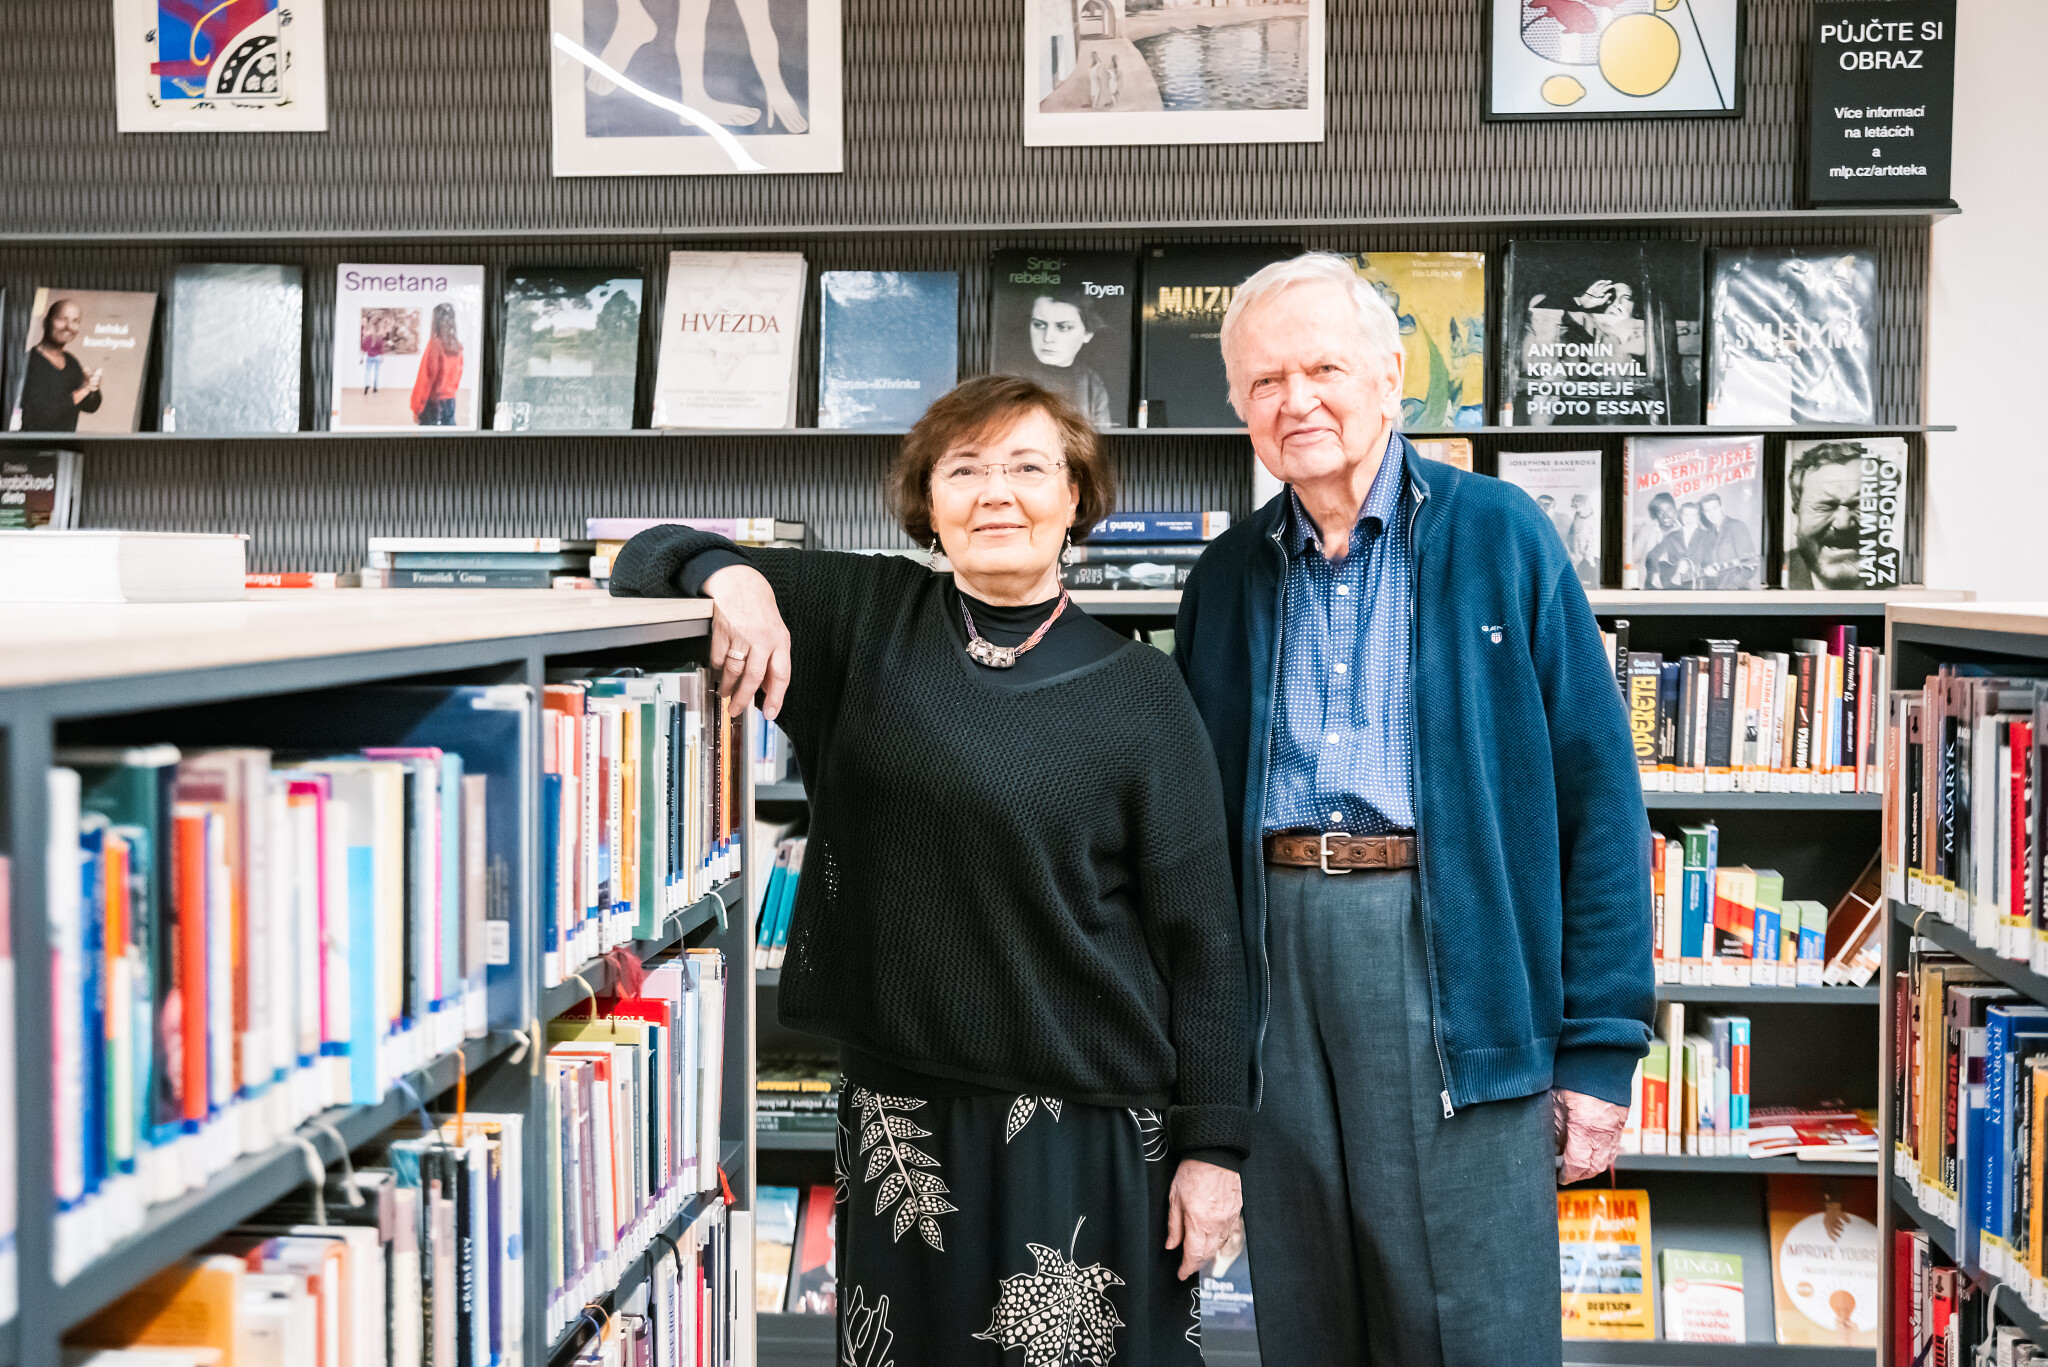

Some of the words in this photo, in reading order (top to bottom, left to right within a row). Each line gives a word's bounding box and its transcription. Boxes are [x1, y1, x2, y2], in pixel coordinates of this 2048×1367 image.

[1820, 19, 1914, 43] PŮJČTE
[1920, 21, 1943, 40] SI
[1839, 50, 1923, 71] OBRAZ
[1834, 106, 1863, 119] Více
[1866, 105, 1926, 118] informací
[1844, 128, 1861, 138] na
[1865, 126, 1914, 138] letácích
[1872, 147, 1881, 157] a
[1829, 164, 1927, 180] mlp.cz/artoteka
[1027, 256, 1062, 271] Snící
[344, 271, 447, 293] Smetana
[1009, 269, 1061, 285] rebelka
[1082, 281, 1124, 297] Toyen
[1159, 286, 1239, 312] MUZI
[681, 308, 780, 333] HVĚZDA
[1735, 321, 1865, 352] SMETANA
[1527, 340, 1613, 358] ANTONÍN
[1527, 359, 1647, 378] KRATOCHVÍL
[1527, 381, 1634, 397] FOTOESEJE
[1527, 401, 1591, 416] PHOTO
[1596, 399, 1665, 416] ESSAYS
[1673, 478, 1702, 499] BOB
[1706, 464, 1756, 487] DYLAN
[1859, 443, 1879, 536] WERICH
[1859, 538, 1878, 587] JAN
[1878, 539, 1897, 585] ZA
[1763, 668, 1773, 703] PRESLEY
[1847, 667, 1856, 690] rytmu
[1630, 675, 1657, 757] OPERETA
[1762, 706, 1770, 727] ELVIS
[1796, 727, 1809, 768] OHAVICA
[1945, 741, 1956, 853] MASARYK
[1992, 1025, 2002, 1101] SVOBODĚ
[1946, 1053, 1957, 1145] Vabank
[1992, 1106, 2001, 1125] KE
[1787, 1243, 1836, 1261] IMPROVE
[1839, 1248, 1877, 1263] YOURS
[1674, 1257, 1735, 1276] LINGEA
